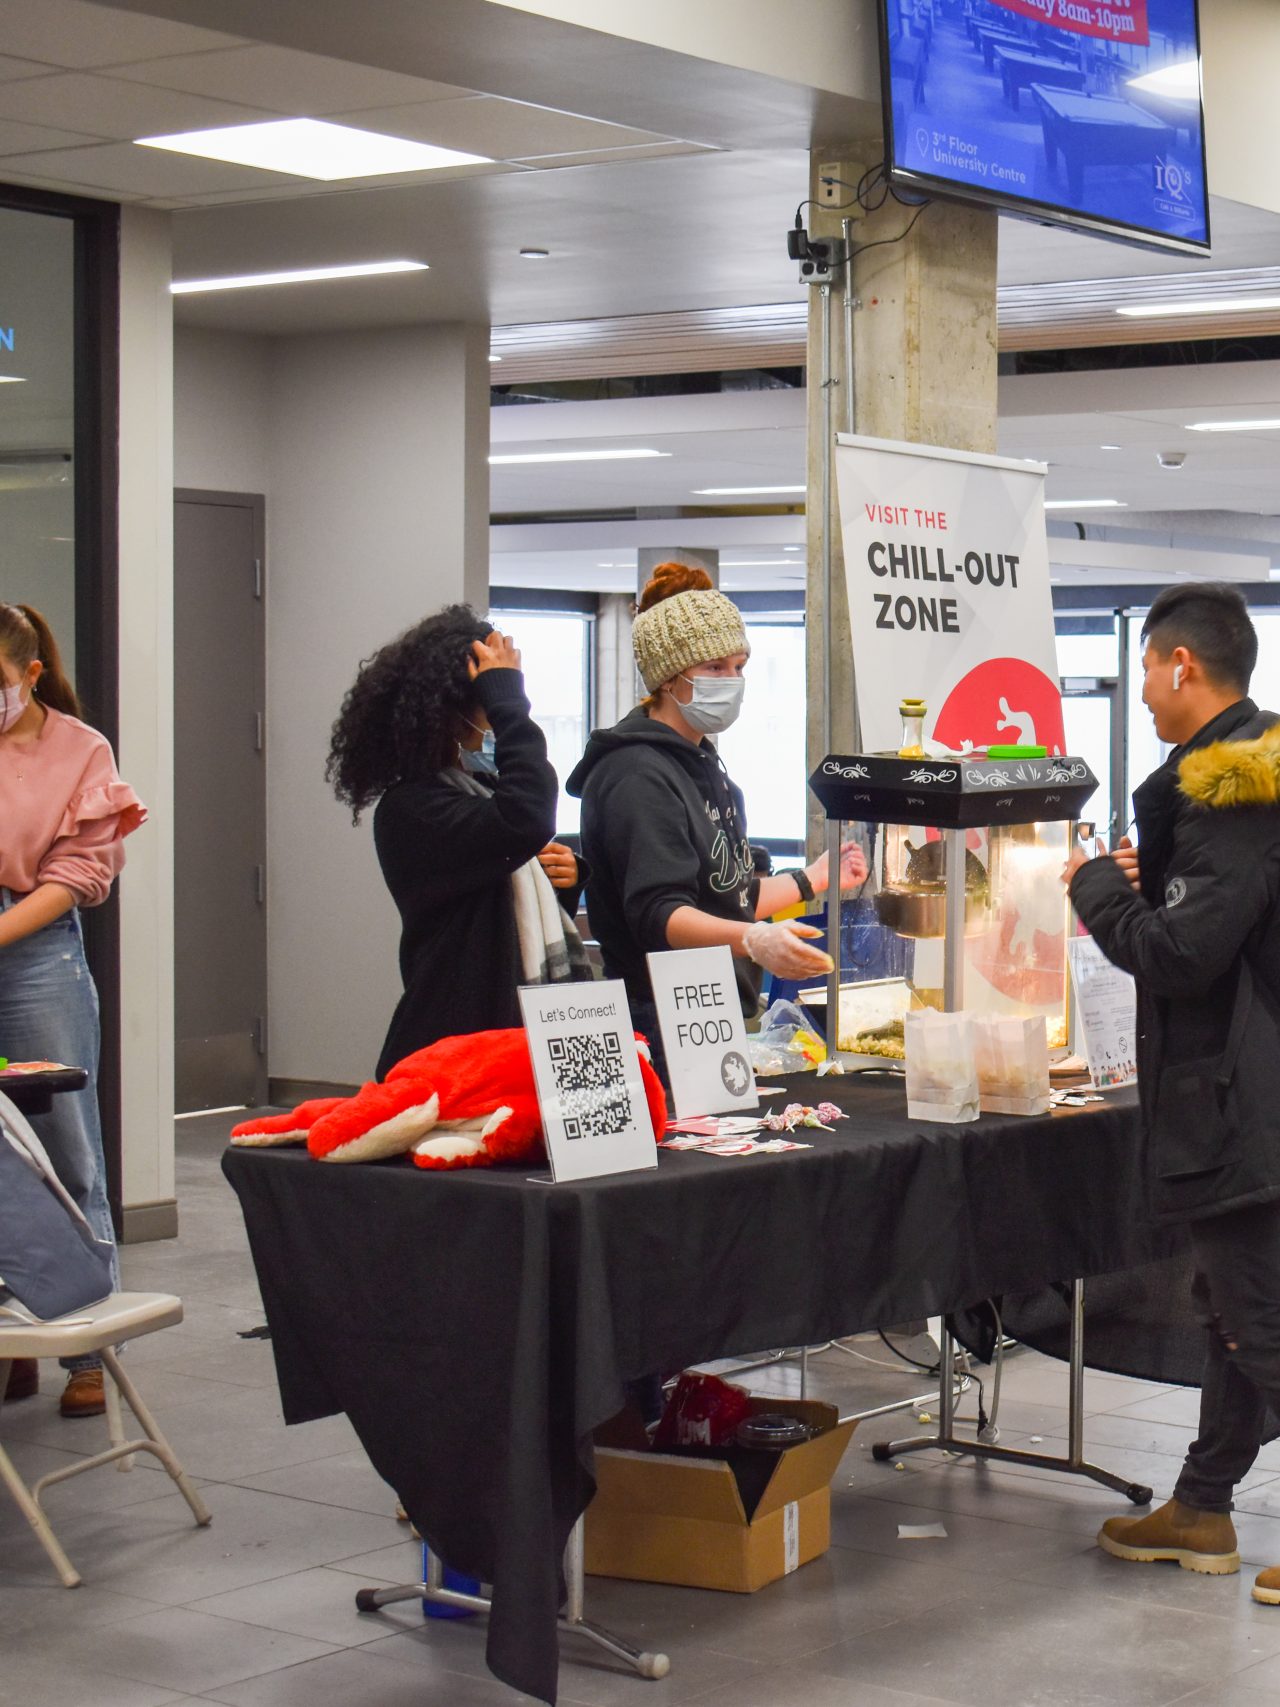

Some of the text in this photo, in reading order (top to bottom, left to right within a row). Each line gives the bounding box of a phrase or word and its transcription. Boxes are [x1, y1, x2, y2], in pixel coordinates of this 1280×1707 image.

[1058, 1, 1136, 36] 8am-10pm
[949, 136, 978, 156] Floor
[933, 147, 1027, 184] University Centre
[865, 503, 948, 530] VISIT THE
[867, 541, 1020, 589] CHILL-OUT
[873, 593, 961, 634] ZONE
[673, 982, 725, 1011] FREE
[539, 1002, 617, 1023] Let's Connect!
[677, 1019, 734, 1048] FOOD
